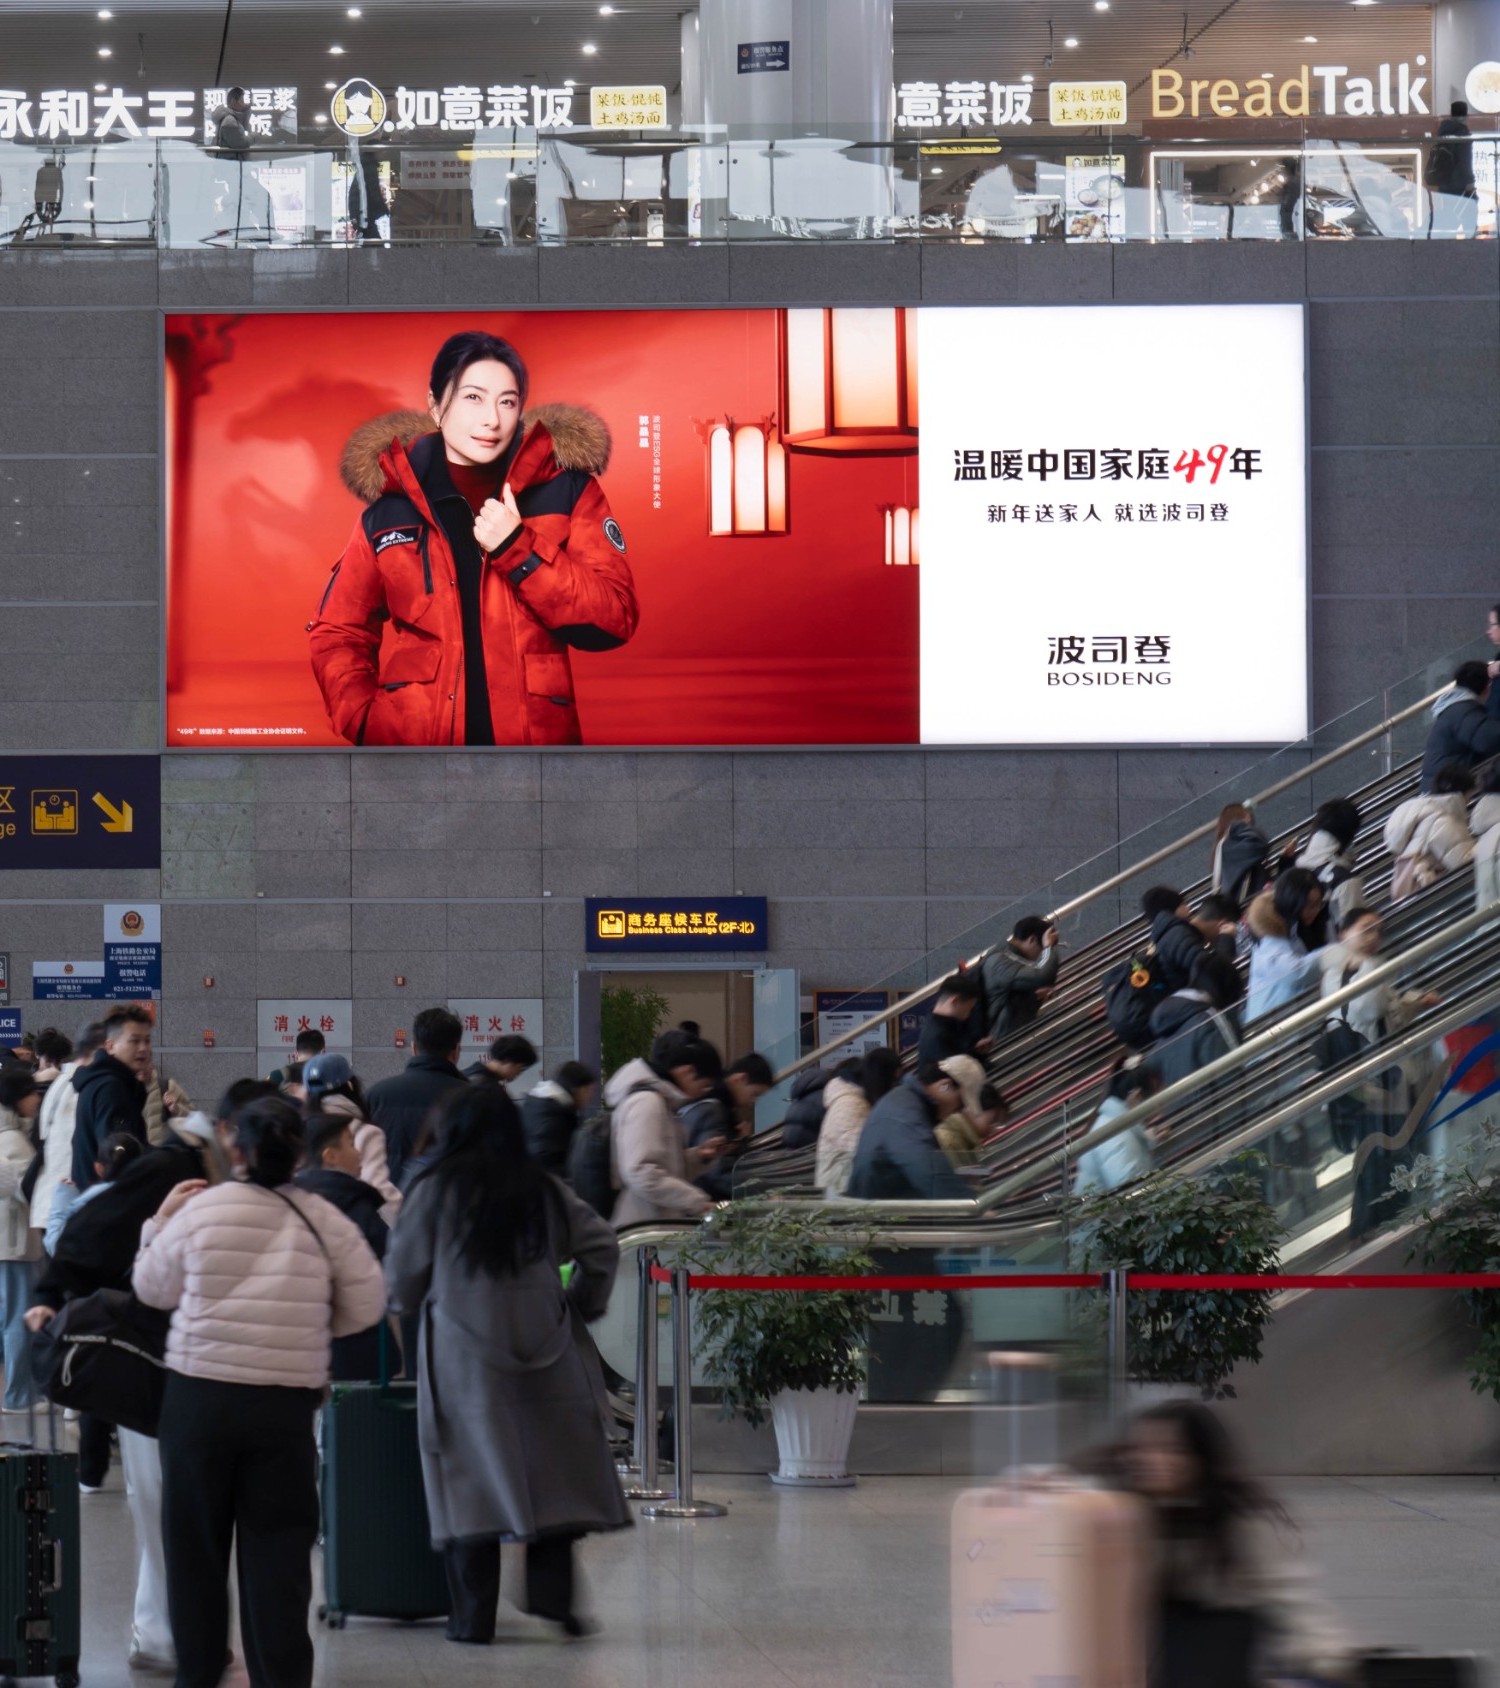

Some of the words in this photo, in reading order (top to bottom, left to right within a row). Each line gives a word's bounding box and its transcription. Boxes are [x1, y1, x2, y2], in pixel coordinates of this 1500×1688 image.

[1152, 55, 1430, 117] BreadTalk
[204, 88, 296, 112] 现豆浆
[394, 86, 574, 130] 如意菜饭
[892, 81, 1033, 127] 意菜饭
[597, 111, 661, 125] 土鸡汤面
[1055, 107, 1120, 121] 土鸡汤面
[954, 444, 1263, 484] 温暖中国家庭49年
[987, 503, 1101, 523] 新年送家人
[1115, 502, 1229, 522] 就选波司登
[1047, 635, 1171, 665] 波司登
[1047, 672, 1171, 686] BOSIDENG
[628, 913, 718, 926] 商务座候车区
[628, 926, 663, 934] Business
[665, 926, 687, 934] Class
[689, 926, 717, 935] Lounge
[274, 1015, 335, 1032] 消火栓
[464, 1015, 525, 1032] 消火栓
